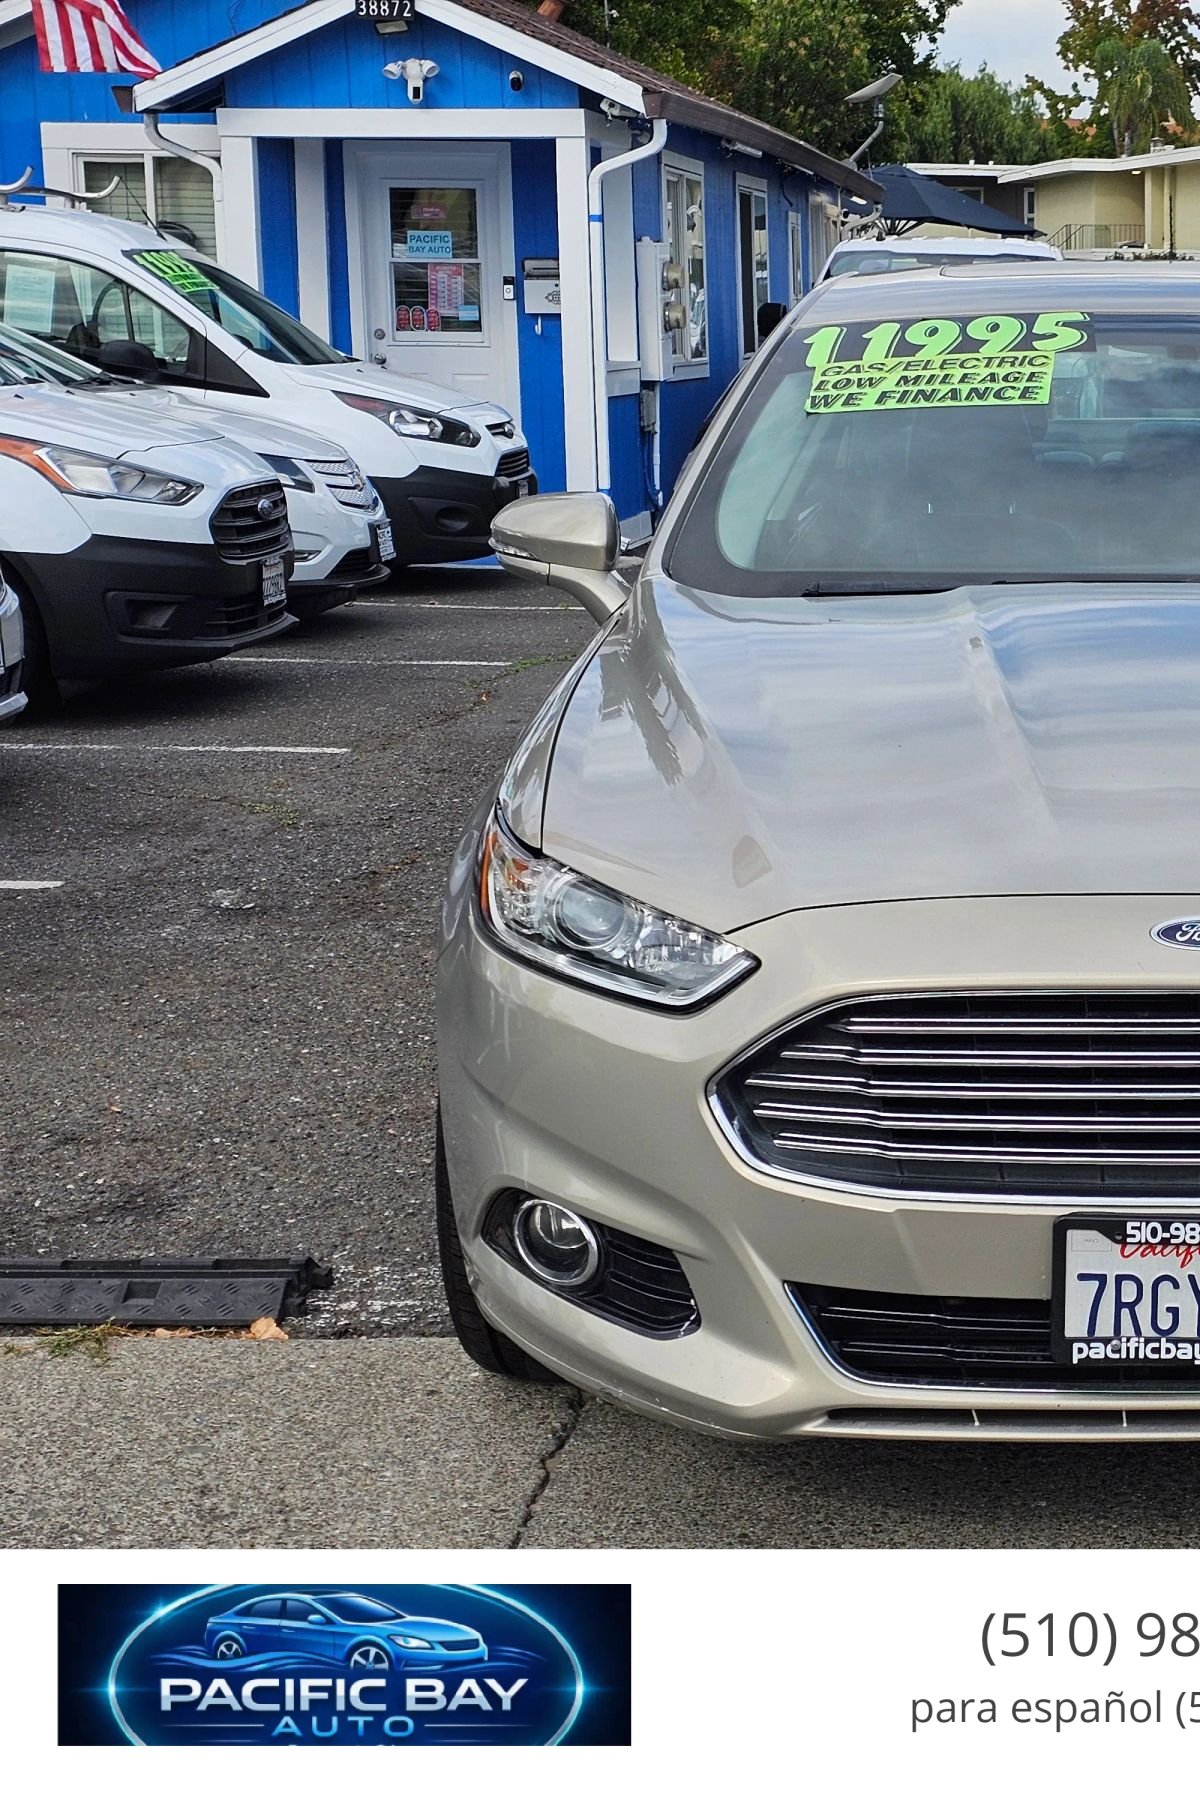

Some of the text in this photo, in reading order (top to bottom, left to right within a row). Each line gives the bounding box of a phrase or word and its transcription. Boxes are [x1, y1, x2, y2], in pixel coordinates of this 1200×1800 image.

[358, 0, 412, 17] 38872
[408, 246, 451, 254] BAY AUTO
[409, 235, 450, 244] PACIFIC
[803, 311, 1090, 368] 11995
[820, 355, 1052, 377] GAS/ELECTRIC
[813, 371, 1046, 392] LOW MILEAGE
[810, 385, 1044, 409] WE FINANCE
